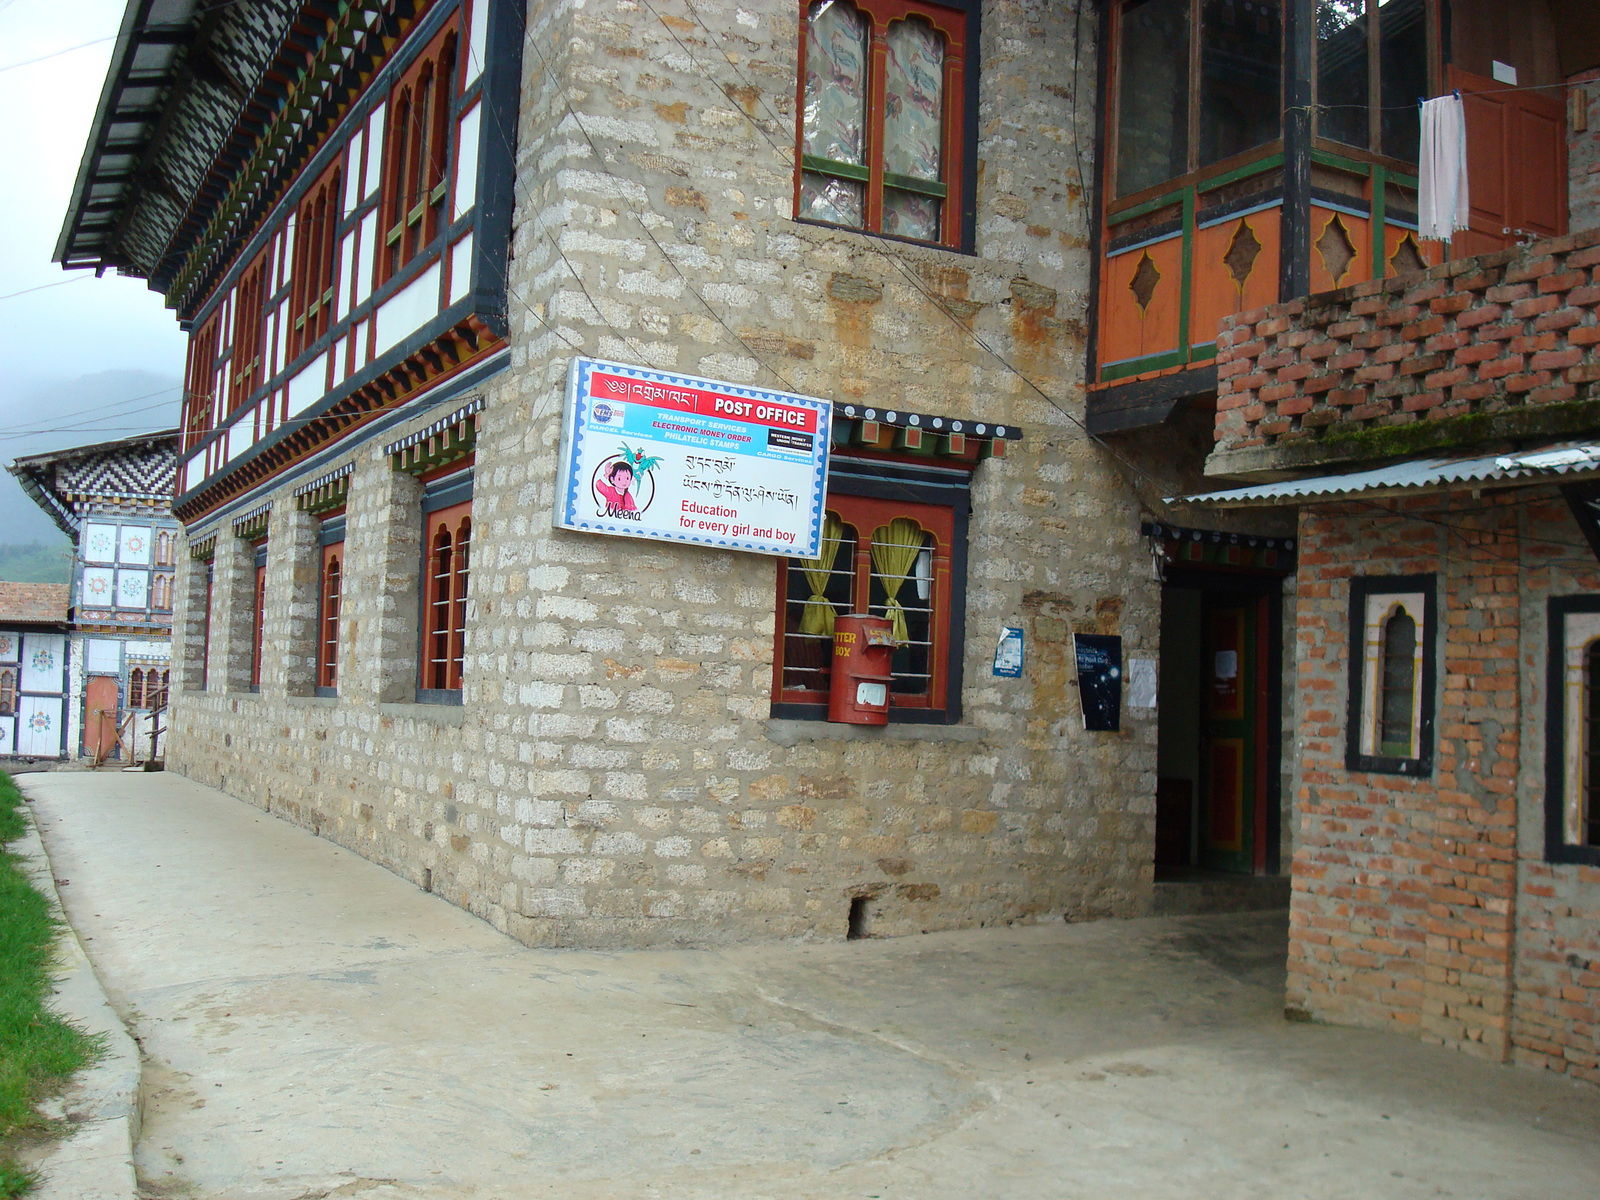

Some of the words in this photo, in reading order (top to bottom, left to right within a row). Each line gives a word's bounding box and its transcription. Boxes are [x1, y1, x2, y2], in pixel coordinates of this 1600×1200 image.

[714, 398, 752, 417] POST
[756, 405, 806, 426] OFFICE
[652, 421, 698, 434] ELECTRONIC
[700, 429, 726, 439] MONEY
[727, 433, 752, 443] ORDER
[657, 412, 707, 426] TRANSPORT
[708, 421, 747, 433] SERVICES
[664, 432, 707, 445] PHILATELIC
[709, 438, 740, 450] STAMPS
[757, 451, 782, 459] CARGO
[596, 502, 642, 521] Meena
[681, 499, 737, 518] Education
[679, 515, 696, 528] for
[698, 520, 729, 536] every
[732, 522, 750, 537] girl
[752, 527, 773, 539] and
[775, 528, 796, 544] boy
